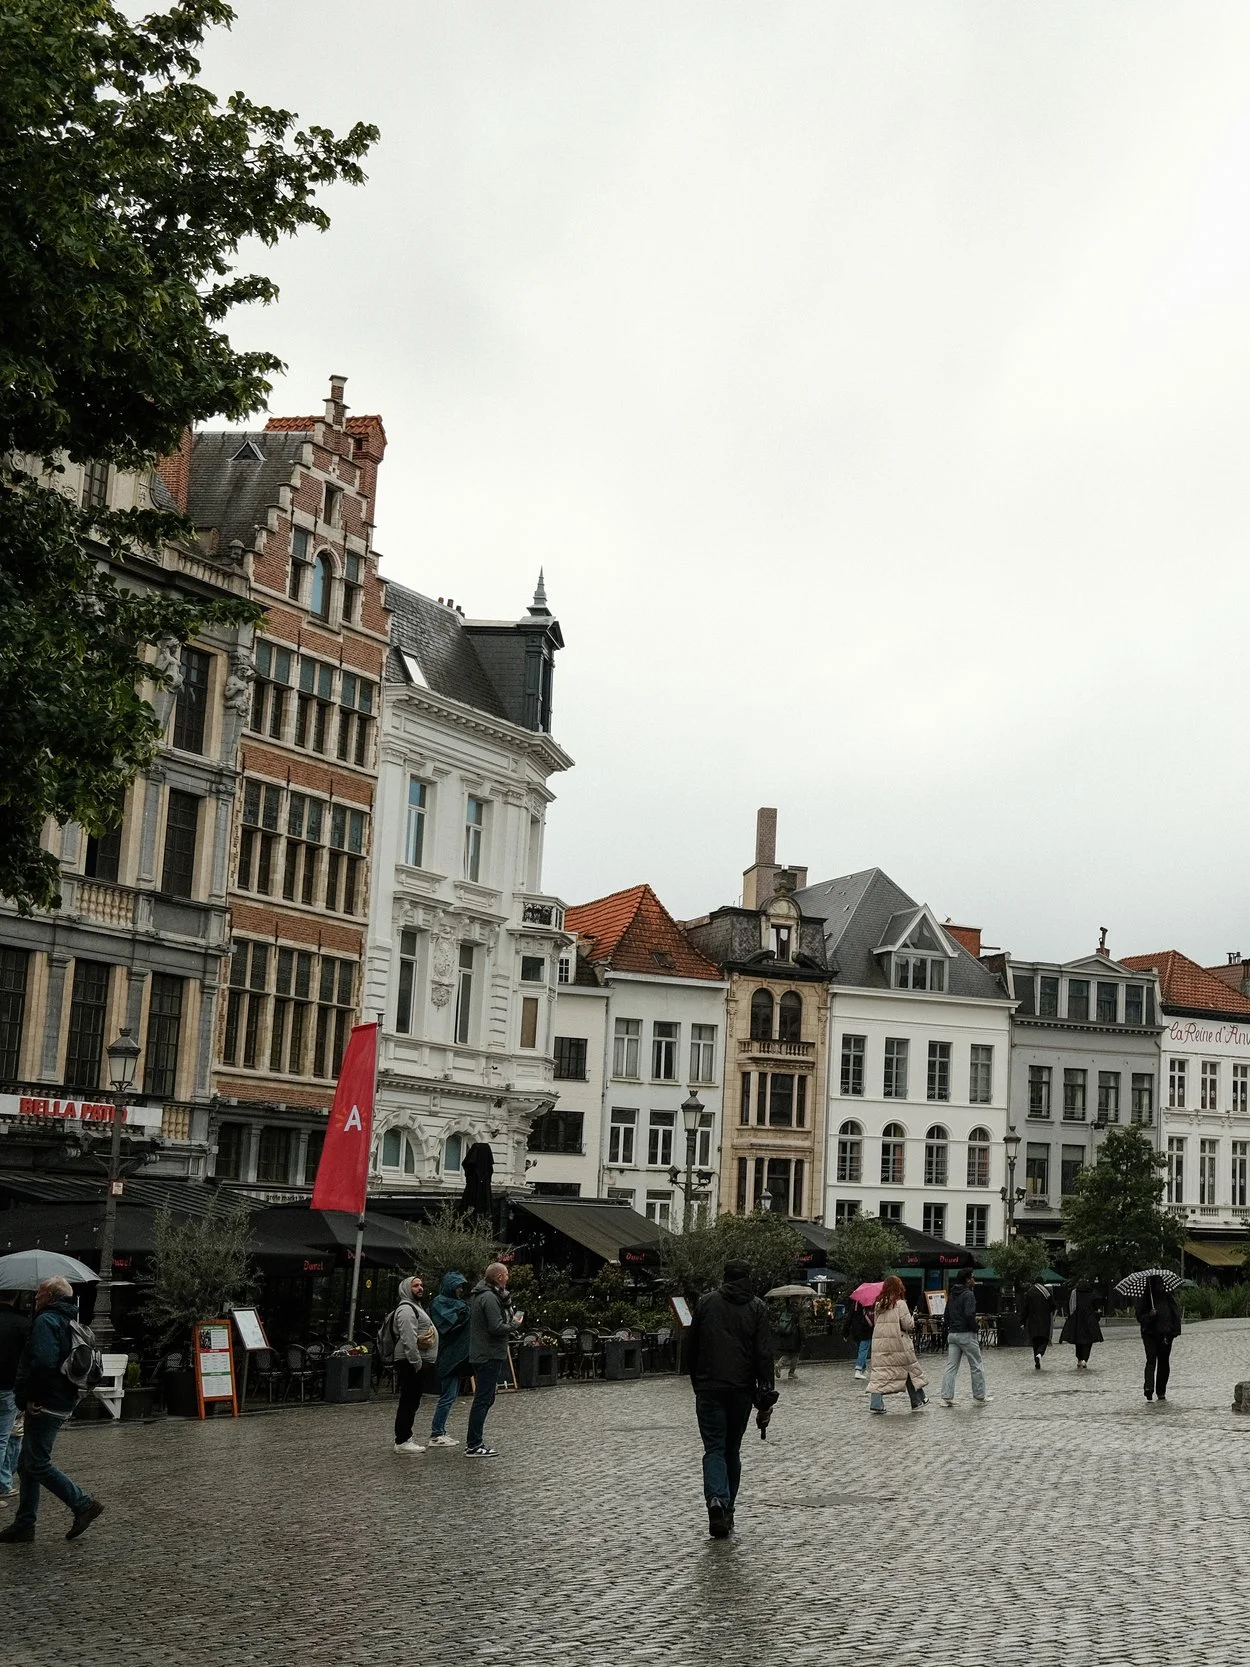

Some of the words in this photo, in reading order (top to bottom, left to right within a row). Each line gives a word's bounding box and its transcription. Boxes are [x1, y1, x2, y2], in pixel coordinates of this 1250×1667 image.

[1182, 1022, 1213, 1044] Reine
[19, 1098, 76, 1119] BELLA
[343, 1104, 362, 1132] A
